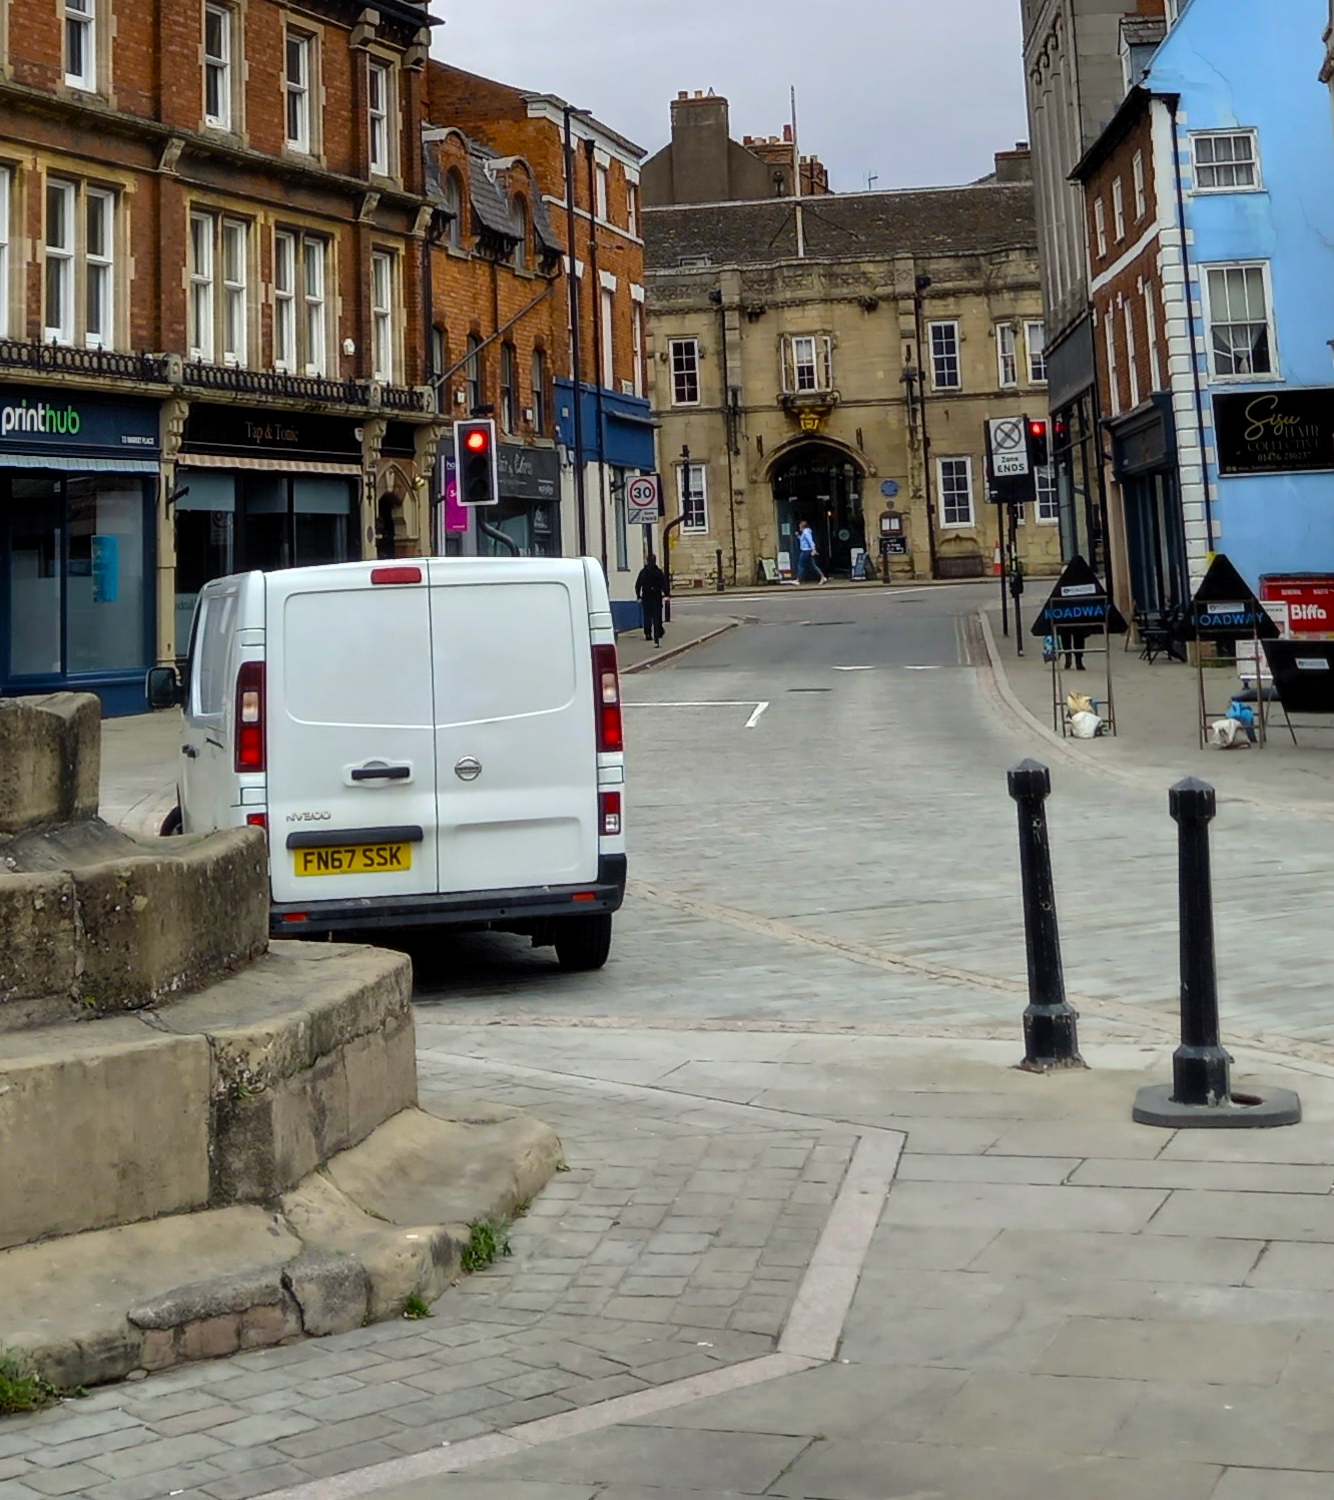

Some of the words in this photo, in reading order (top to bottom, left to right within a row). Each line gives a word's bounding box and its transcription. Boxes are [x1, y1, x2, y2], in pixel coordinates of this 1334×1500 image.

[1, 399, 80, 436] printhub
[1244, 394, 1301, 441] Sisu
[245, 421, 263, 444] Tap
[264, 425, 273, 440] &
[274, 423, 299, 443] Tonic
[1285, 425, 1319, 438] HAIR
[1001, 455, 1019, 464] Zone
[997, 463, 1025, 473] ENDS
[633, 486, 652, 499] 30
[1290, 603, 1327, 620] Biffa
[286, 810, 332, 822] NV300
[303, 848, 356, 872] FN67
[362, 845, 402, 868] SSK
